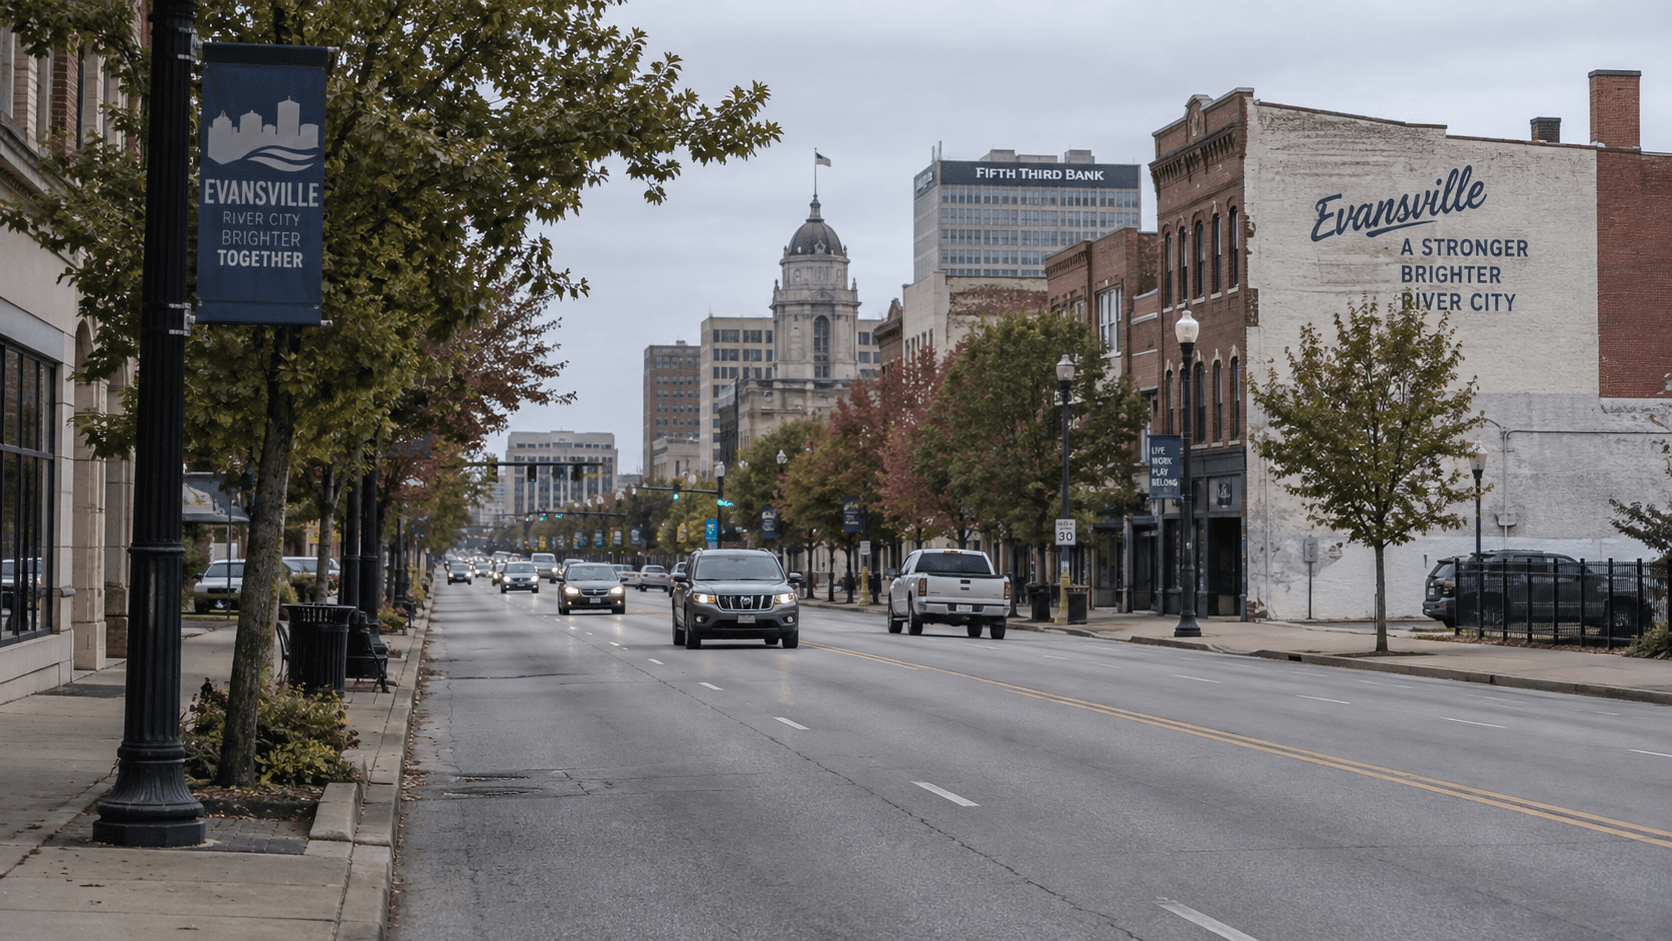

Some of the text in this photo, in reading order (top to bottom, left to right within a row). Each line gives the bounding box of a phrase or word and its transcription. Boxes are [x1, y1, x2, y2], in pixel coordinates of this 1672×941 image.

[975, 167, 1105, 181] FIFTH THIRD BANK
[204, 178, 320, 208] EVANSVILLE
[1310, 164, 1488, 242] Evansville
[222, 210, 301, 226] RIVER CITY
[221, 229, 301, 247] BRIGHTER
[1400, 238, 1529, 257] A STRONGER
[217, 249, 303, 268] TOGETHER
[1401, 265, 1501, 284] BRIGHTER
[1401, 292, 1516, 312] RIVER CITY
[1058, 531, 1073, 542] 30
